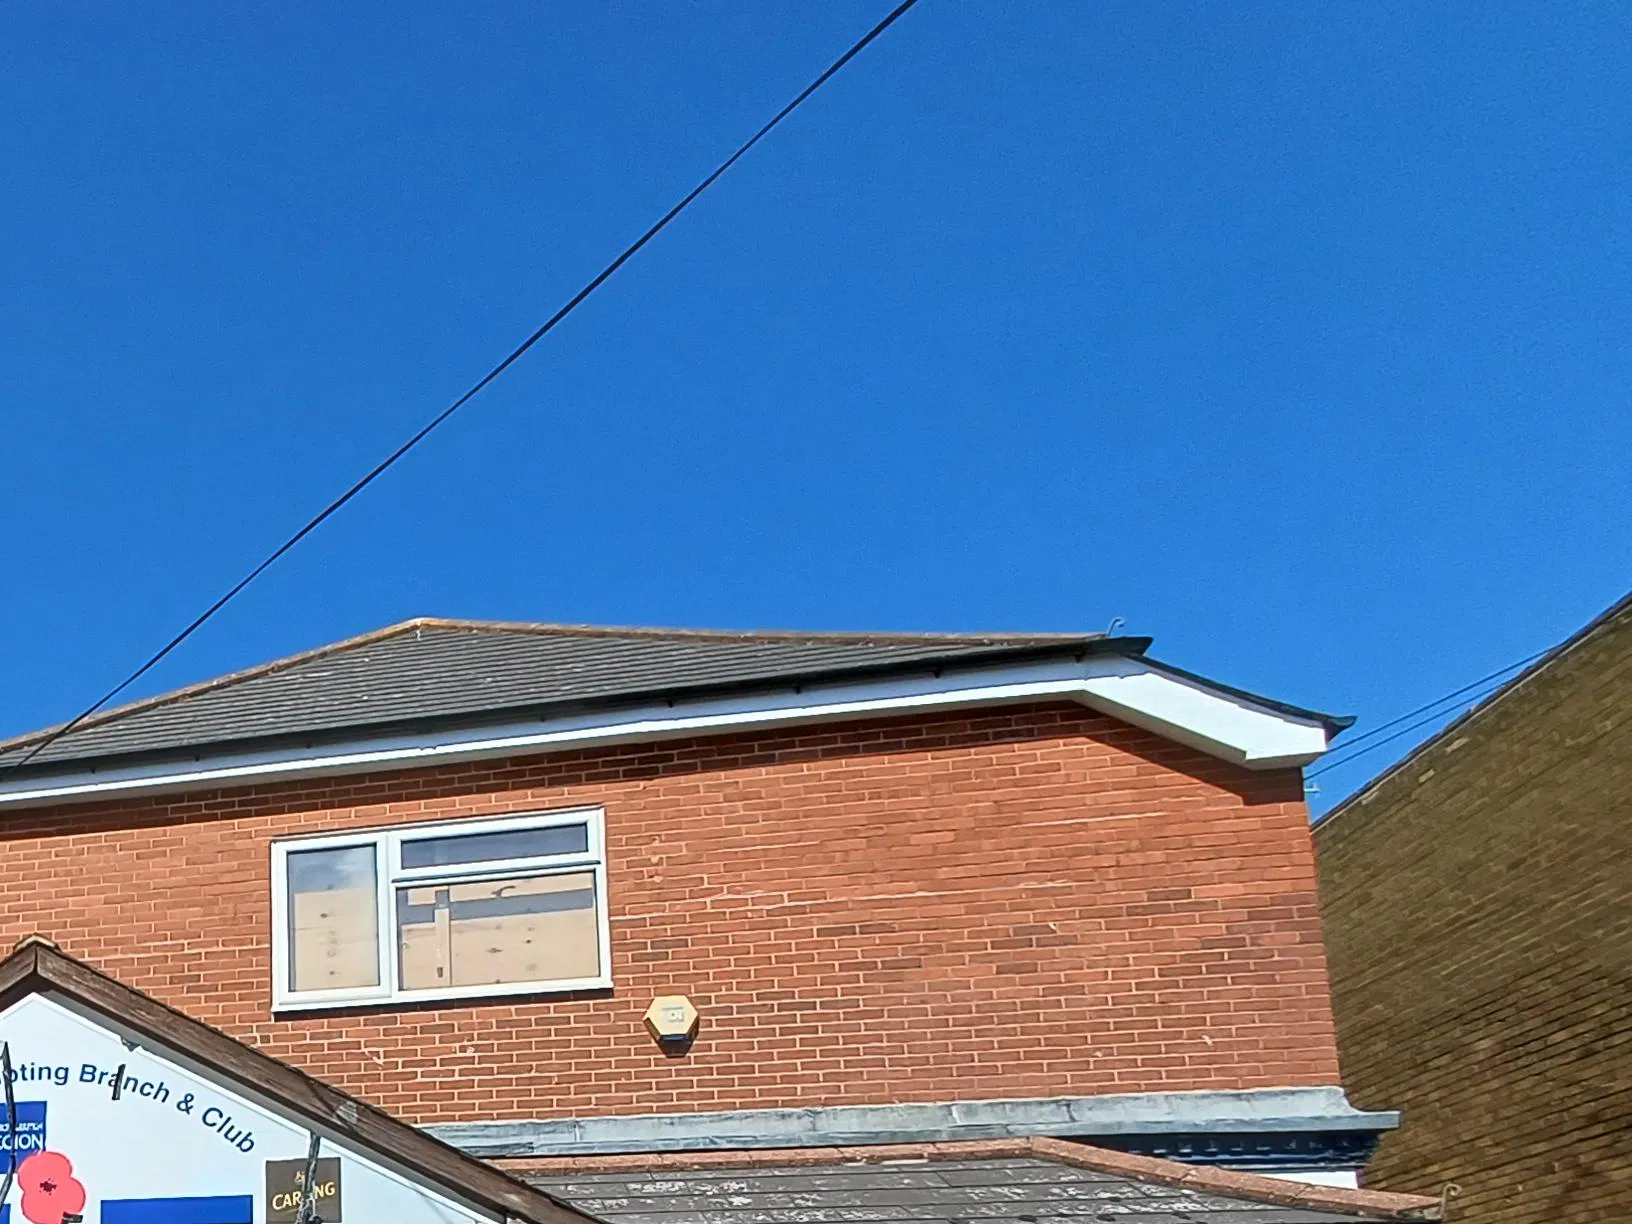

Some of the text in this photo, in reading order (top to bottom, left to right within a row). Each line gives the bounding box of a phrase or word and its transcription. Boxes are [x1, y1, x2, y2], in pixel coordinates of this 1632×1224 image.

[79, 1064, 170, 1103] Branch
[176, 1093, 195, 1115] &
[202, 1107, 255, 1153] Club
